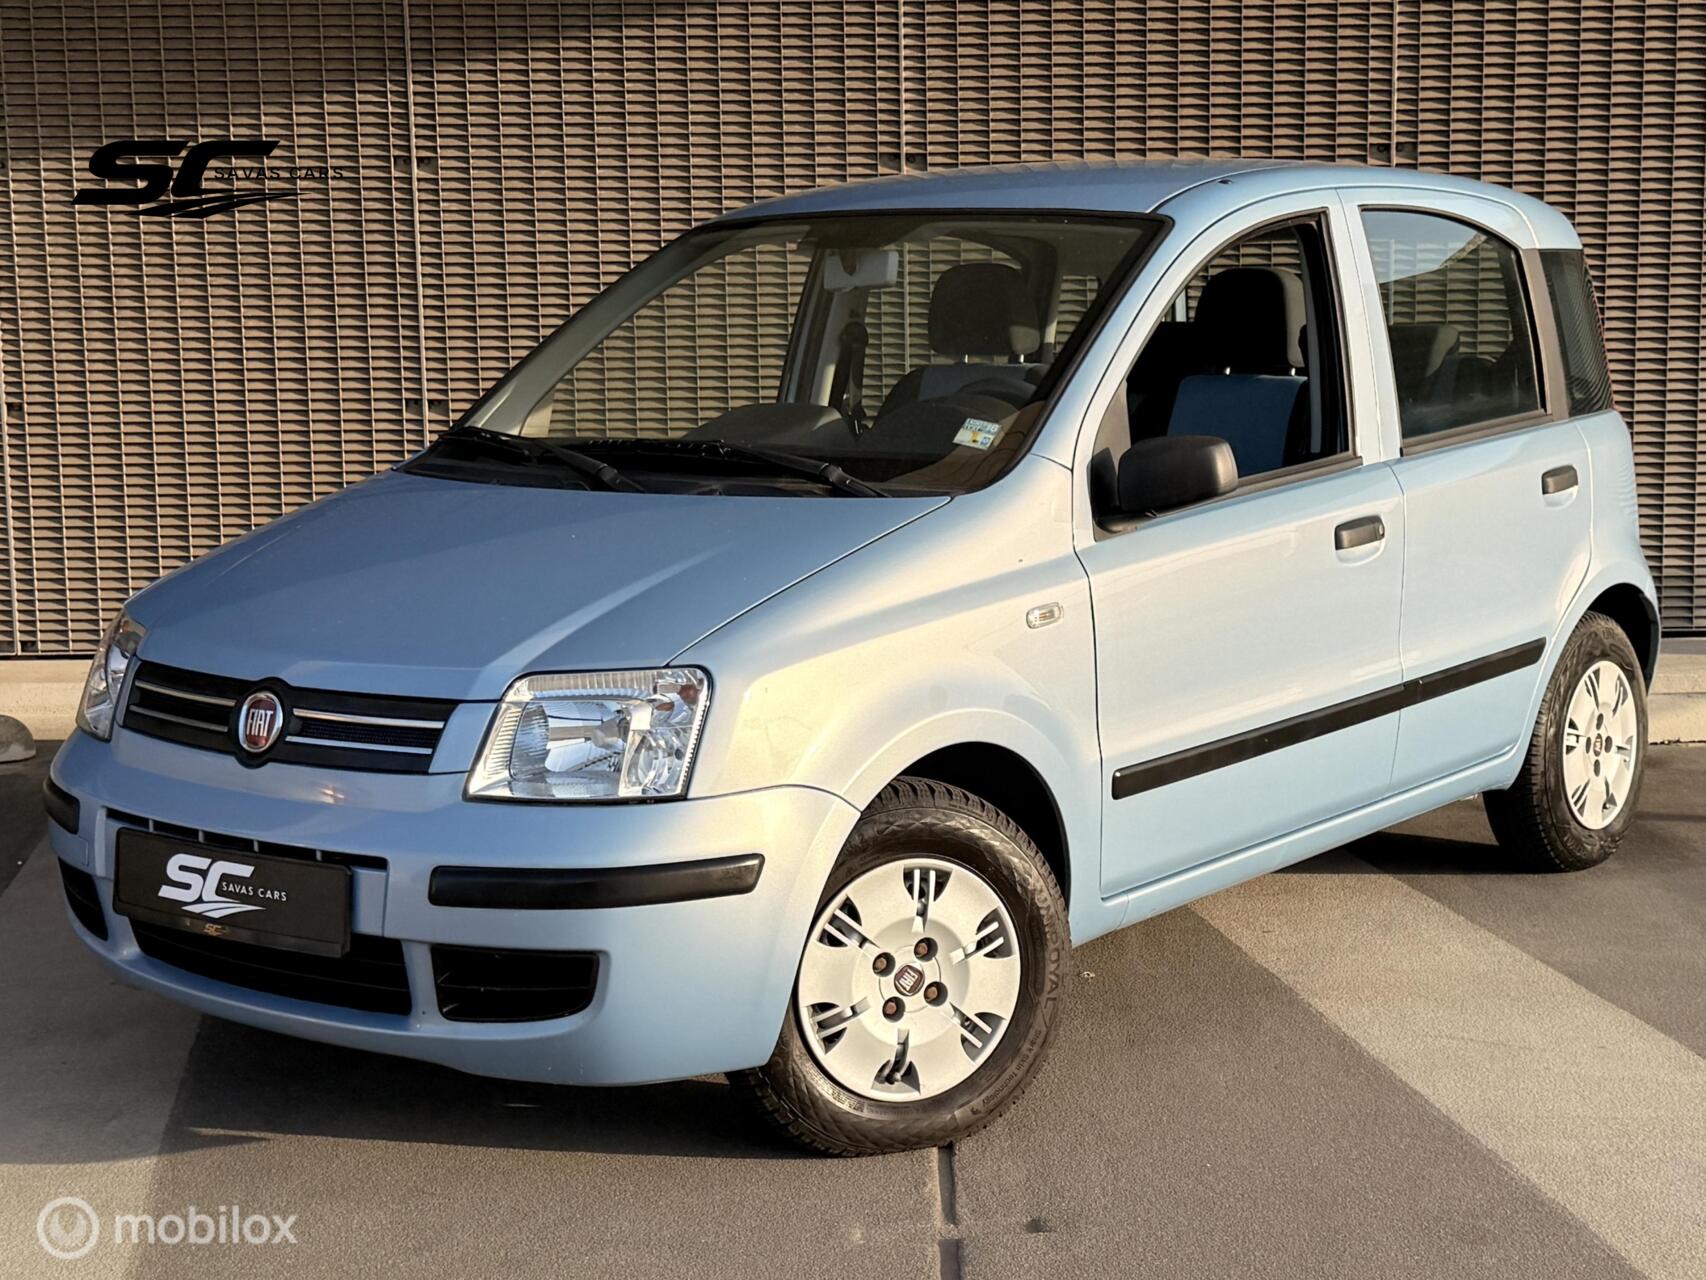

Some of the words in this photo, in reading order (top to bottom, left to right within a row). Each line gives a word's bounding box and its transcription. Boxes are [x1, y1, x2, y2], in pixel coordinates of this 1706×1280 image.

[246, 708, 274, 736] FIAT
[158, 853, 255, 903] SC
[222, 881, 254, 896] SAVAS
[258, 887, 287, 901] CARS
